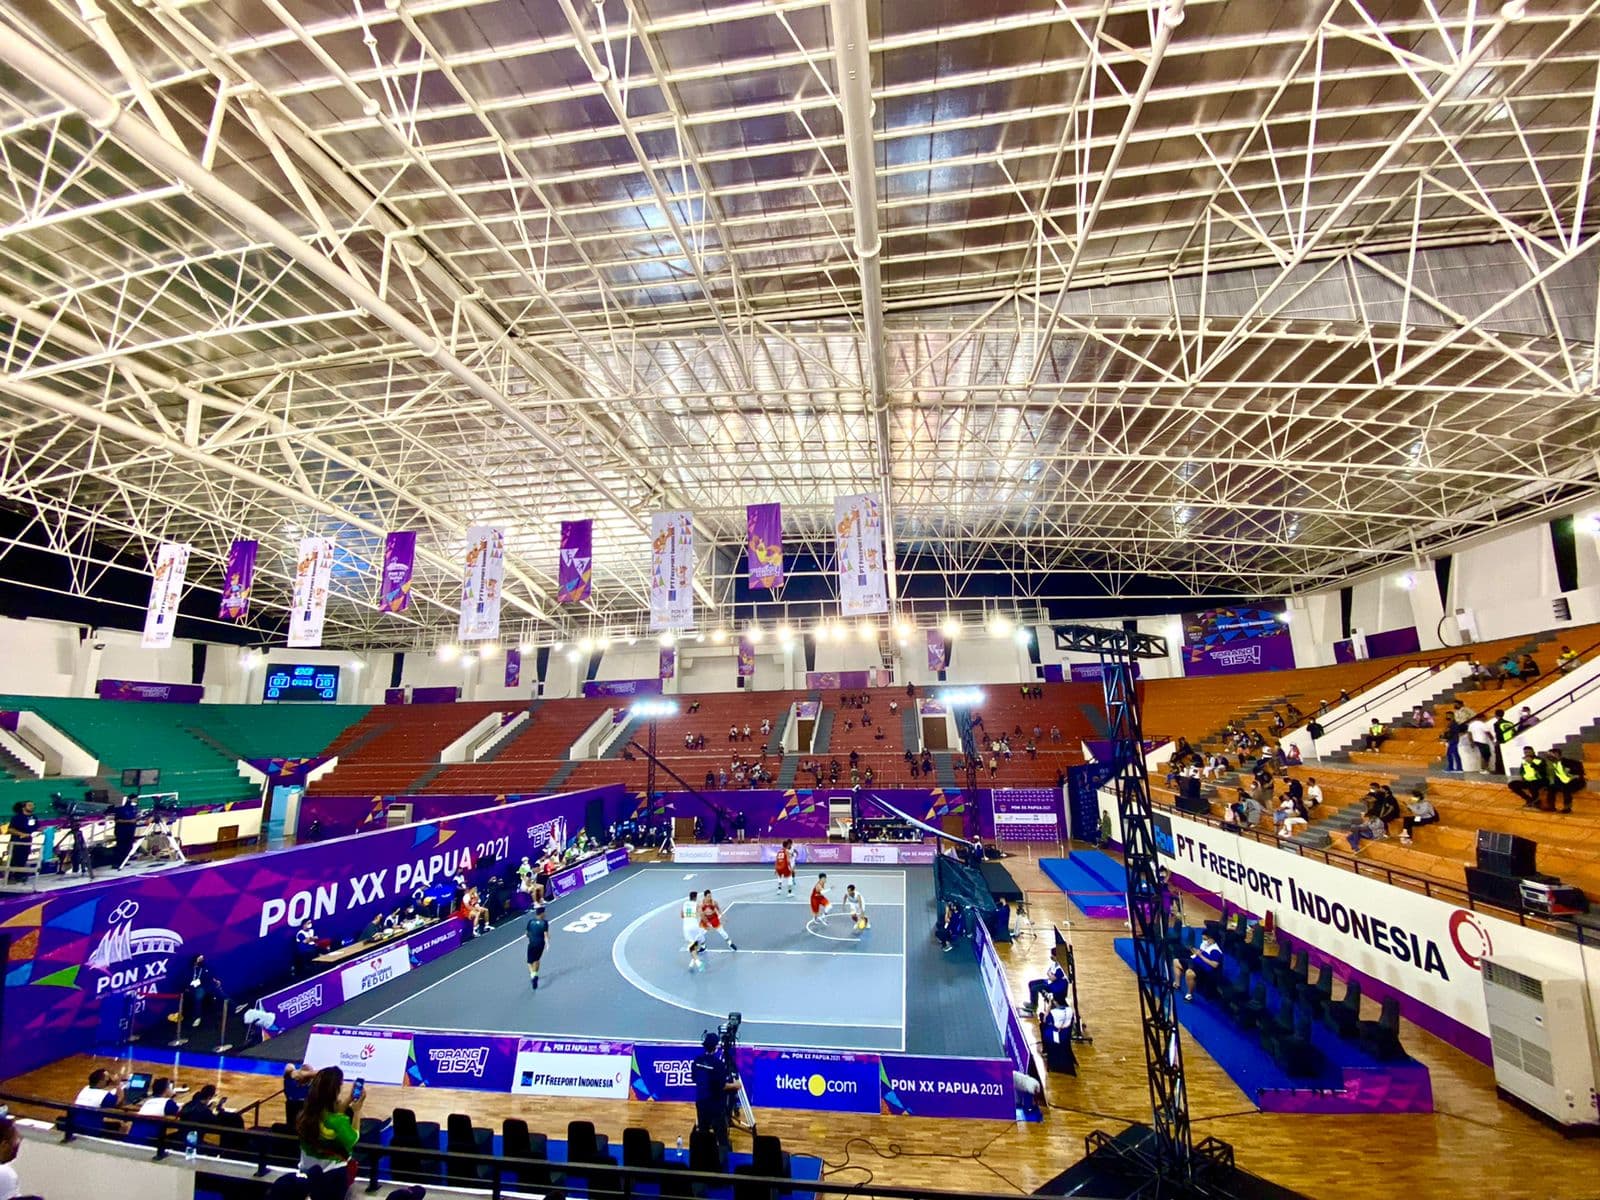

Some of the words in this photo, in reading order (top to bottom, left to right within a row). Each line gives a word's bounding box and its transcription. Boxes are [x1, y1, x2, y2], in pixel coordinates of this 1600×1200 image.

[259, 882, 338, 938] PON
[347, 869, 388, 910] XX
[395, 846, 473, 894] PAPUA
[1177, 833, 1195, 863] PT
[1198, 841, 1283, 903] FREEPORT
[1289, 877, 1450, 982] INDONESIA
[97, 967, 139, 994] PON
[144, 958, 168, 980] XX
[361, 970, 393, 990] PEDULI
[429, 1048, 479, 1060] TORANG
[535, 1073, 545, 1085] PT
[546, 1075, 578, 1087] FREEPORT
[579, 1075, 614, 1088] INDONESIA
[891, 1079, 916, 1092] PON
[919, 1079, 935, 1093] XX
[938, 1081, 979, 1095] PAPUA
[980, 1084, 1004, 1096] 2021
